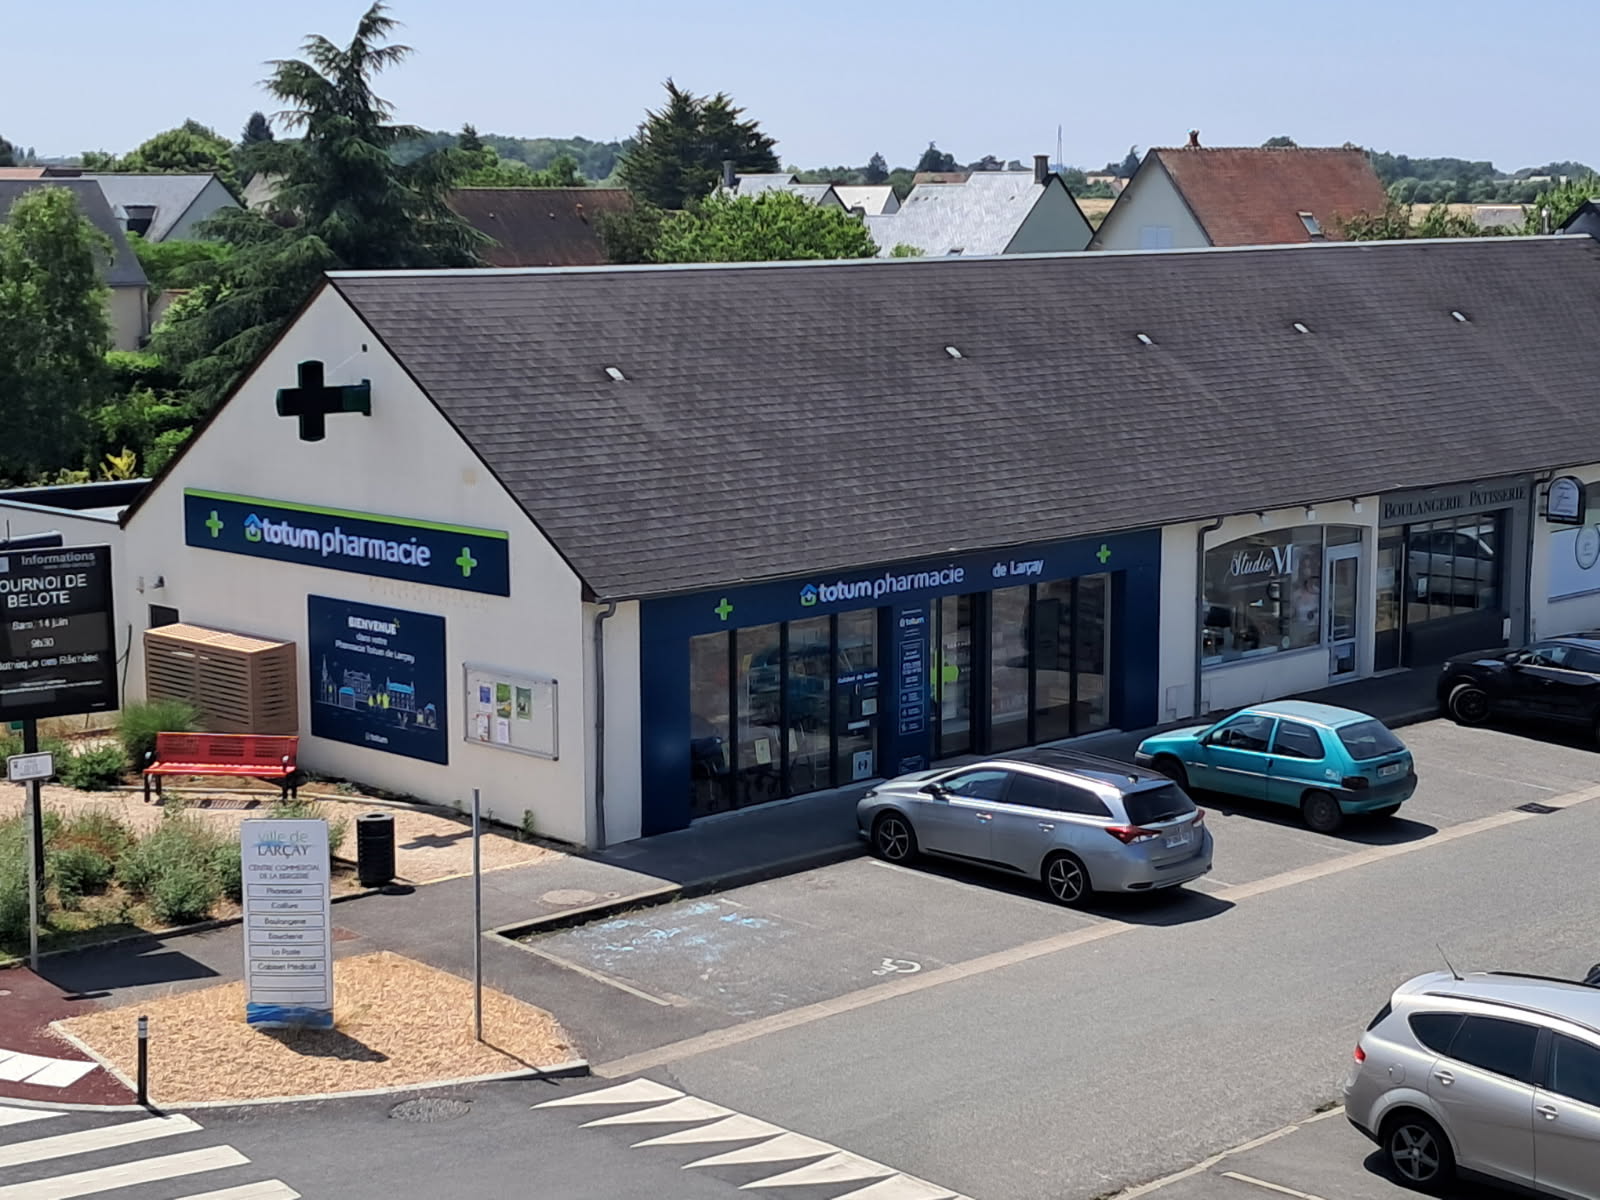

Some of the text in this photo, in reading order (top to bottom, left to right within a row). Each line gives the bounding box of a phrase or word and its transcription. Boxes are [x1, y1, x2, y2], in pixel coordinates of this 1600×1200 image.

[1384, 495, 1463, 519] BOULANGERIE
[321, 526, 431, 567] pharmacie
[21, 552, 96, 565] Informations
[1230, 550, 1273, 577] Studio
[64, 573, 88, 588] DE
[873, 563, 965, 599] pharmacie
[992, 562, 1007, 578] de
[1010, 559, 1045, 577] Larçay
[7, 590, 71, 608] BELOTE
[348, 616, 397, 636] BIENVENUE
[258, 831, 309, 843] ville de
[257, 844, 312, 859] LARÇAY
